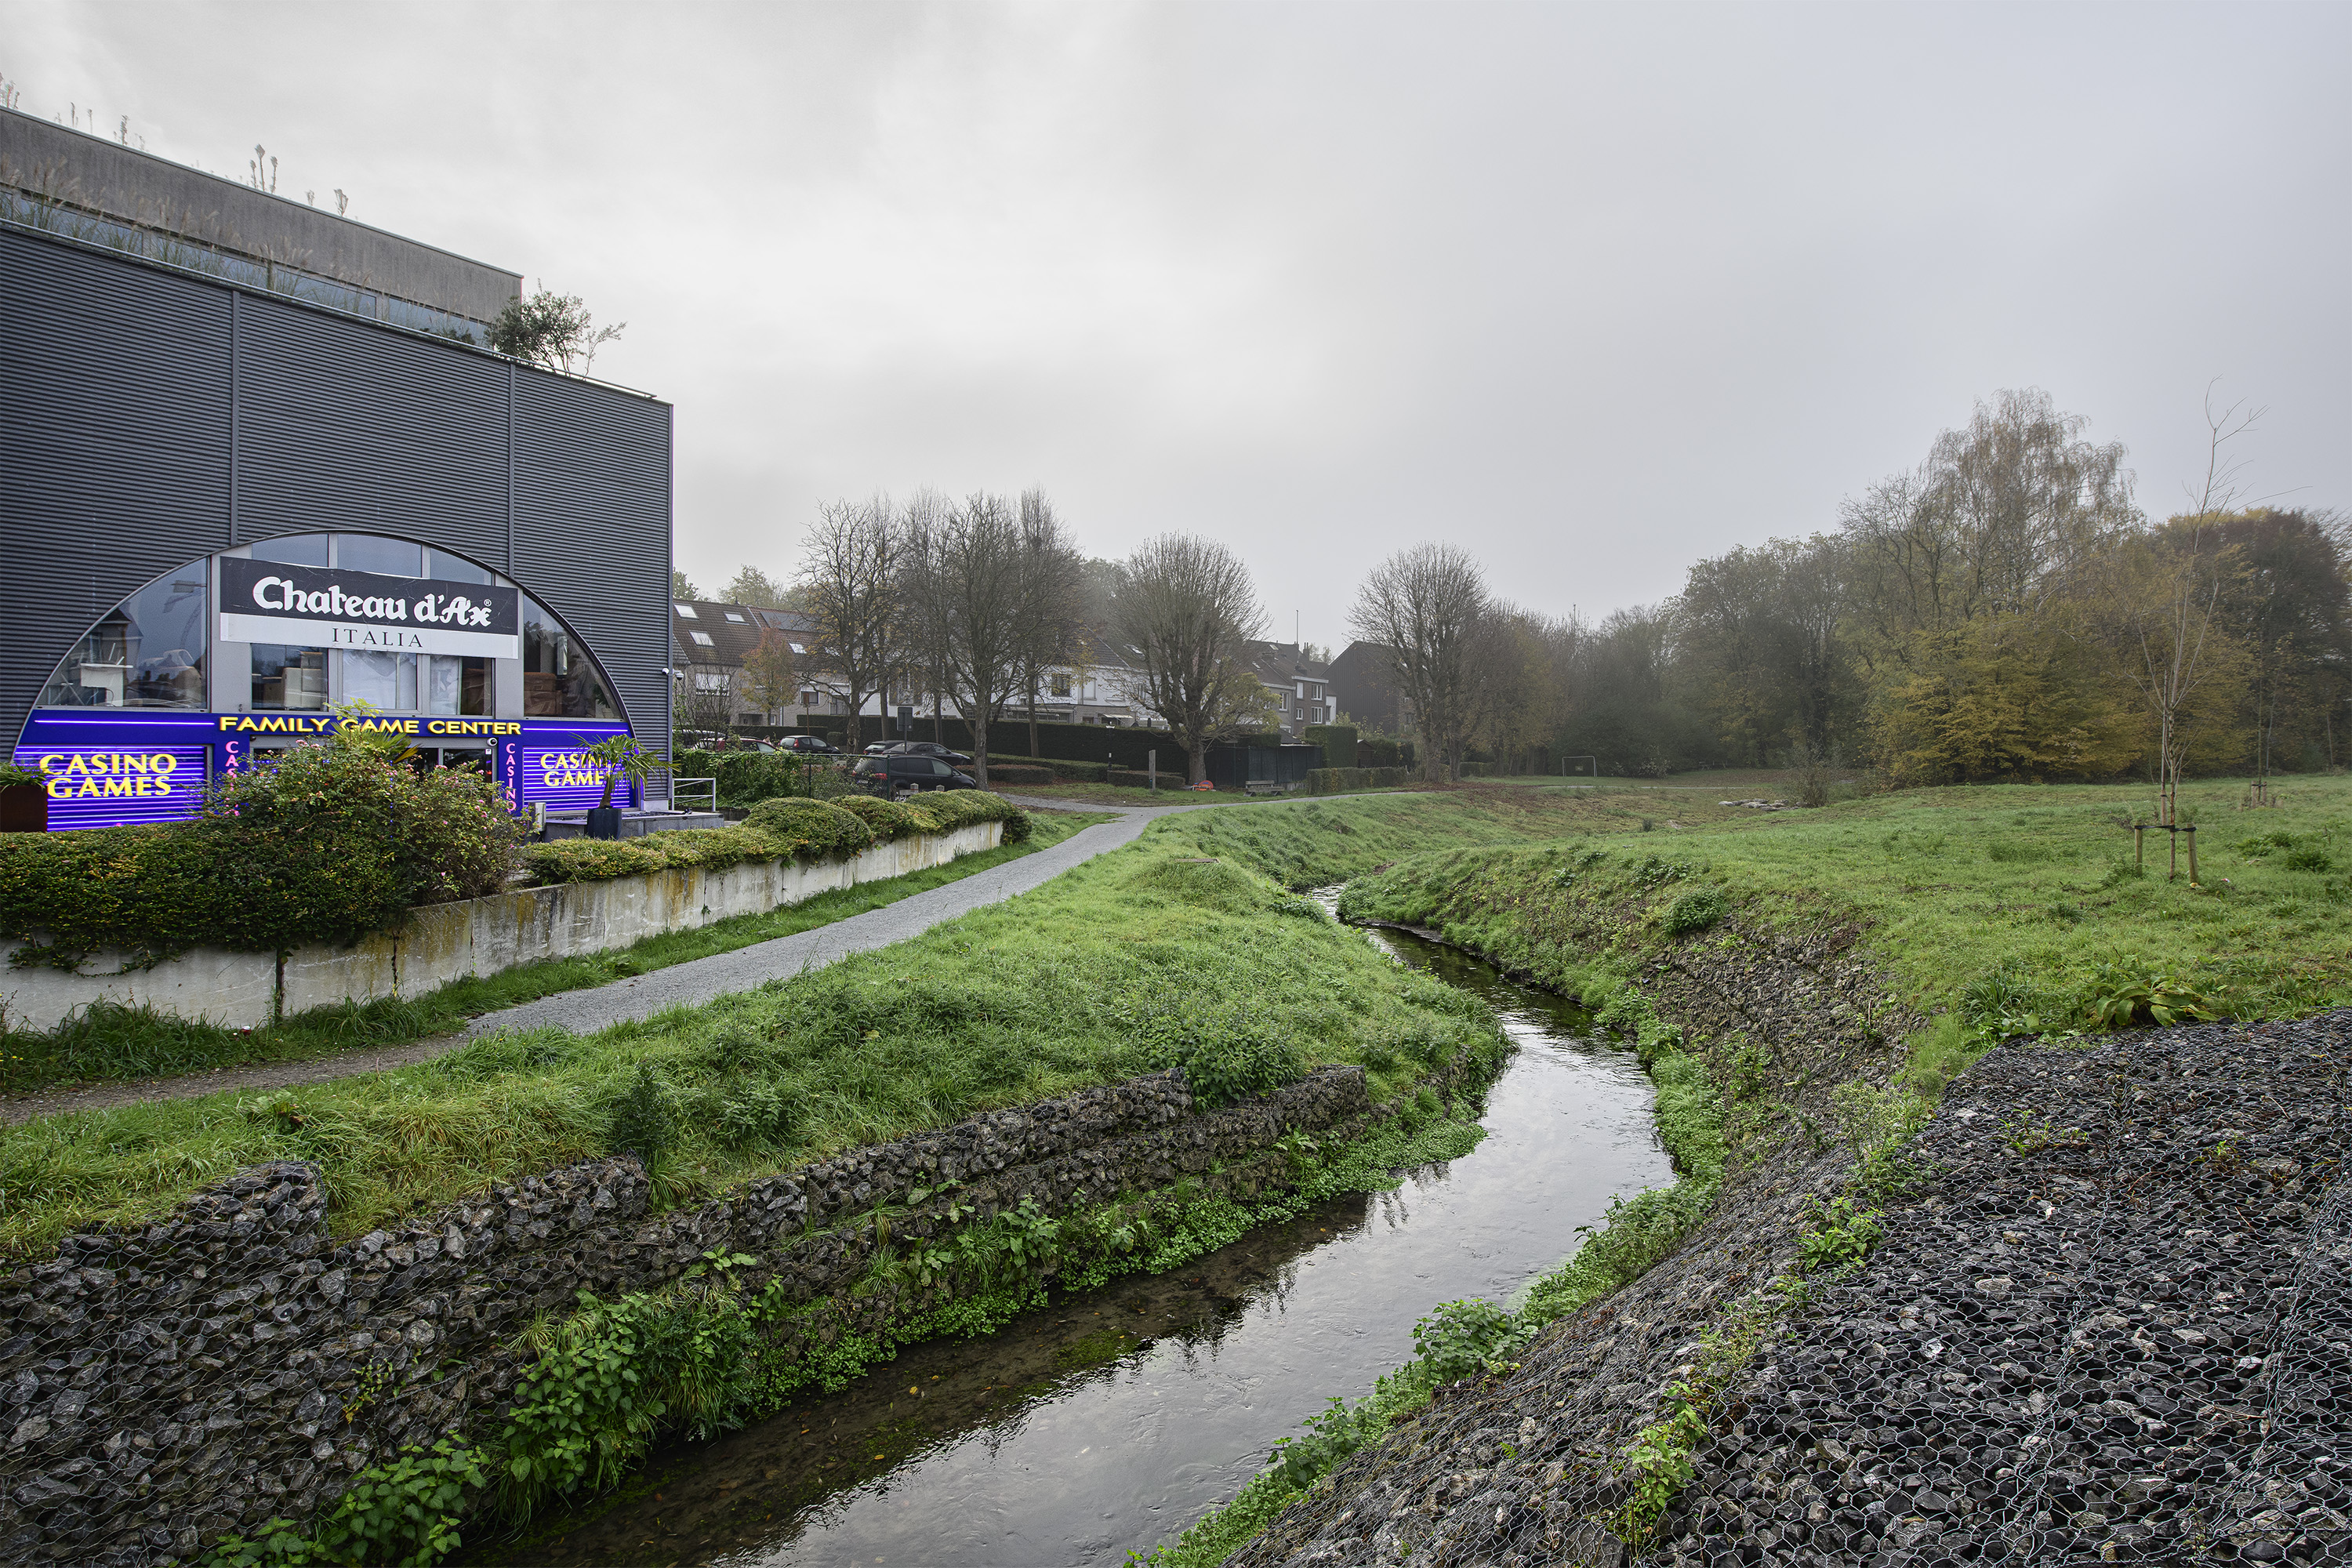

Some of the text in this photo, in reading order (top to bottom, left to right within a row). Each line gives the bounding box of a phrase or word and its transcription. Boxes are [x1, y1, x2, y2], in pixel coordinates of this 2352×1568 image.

[252, 576, 408, 621] Chateau
[332, 627, 423, 648] ITALIA
[220, 717, 521, 735] FAMILY GAME CENTER
[39, 753, 177, 775] CASINO
[47, 776, 172, 798] GAMES
[506, 742, 517, 811] CASINO
[544, 771, 611, 786] GAME
